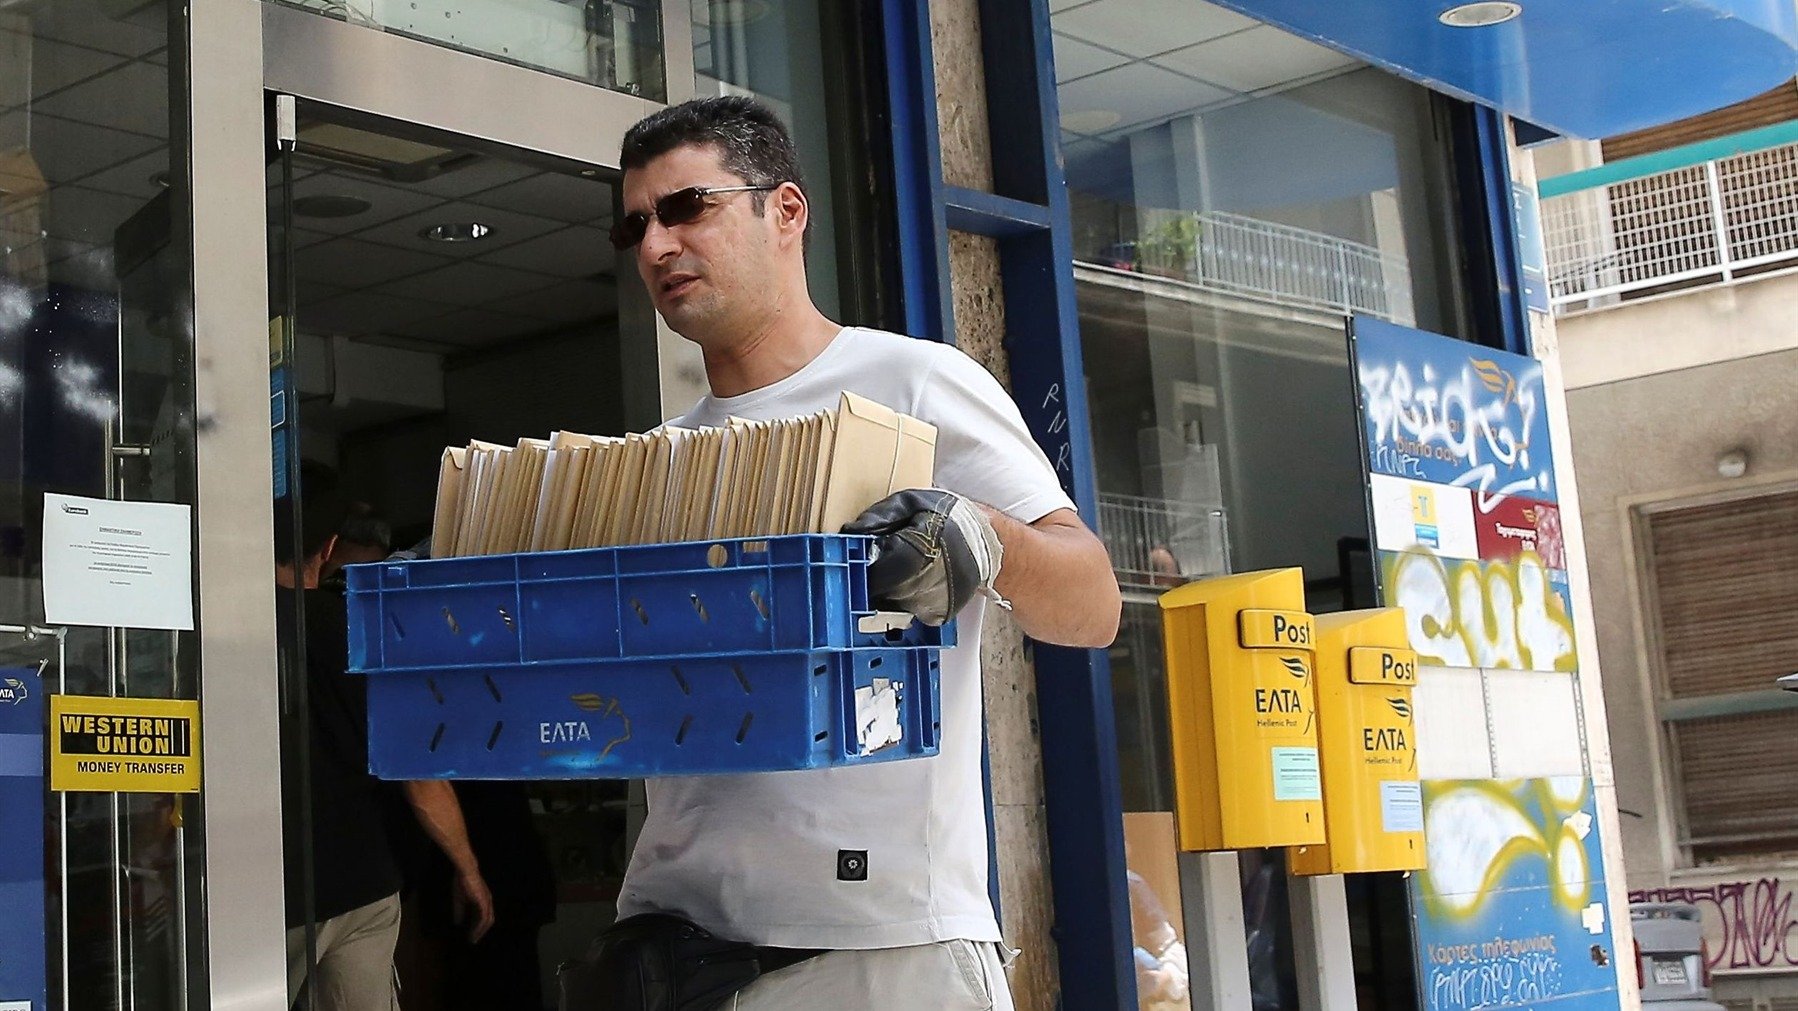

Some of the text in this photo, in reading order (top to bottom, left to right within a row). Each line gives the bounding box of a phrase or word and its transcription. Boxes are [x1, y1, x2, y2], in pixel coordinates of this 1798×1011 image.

[1273, 615, 1311, 644] Post
[1382, 653, 1415, 680] Post
[1255, 688, 1302, 713] ΕΛΤΑ
[61, 715, 169, 736] WESTERN
[540, 721, 591, 743] ΕΛΤΑ
[96, 735, 169, 755] UNION
[1363, 728, 1407, 751] ΕΛΤΑ
[77, 761, 185, 775] MONEY TRANSFER
